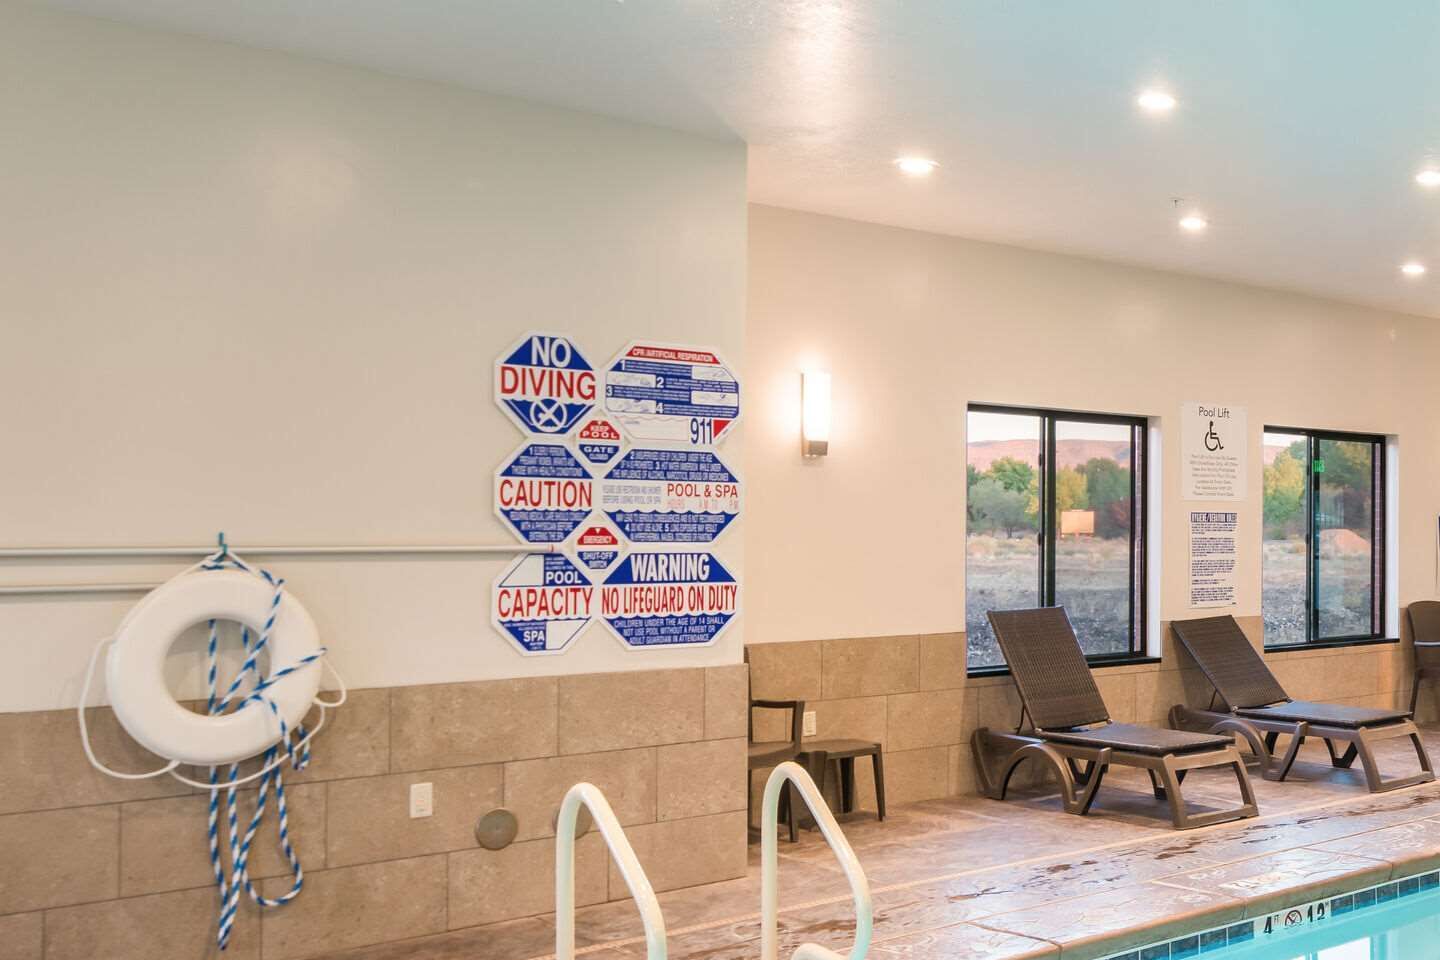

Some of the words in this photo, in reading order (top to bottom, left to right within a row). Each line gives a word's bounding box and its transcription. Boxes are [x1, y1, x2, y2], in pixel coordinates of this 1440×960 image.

[531, 336, 571, 368] NO
[500, 366, 596, 400] DIVING
[656, 377, 665, 389] 2
[606, 386, 613, 396] 3
[656, 403, 664, 414] 4
[1198, 406, 1216, 418] Pool
[1217, 408, 1230, 419] Lift
[582, 430, 617, 439] POOL
[690, 418, 713, 445] 911
[500, 479, 592, 507] CAUTION
[667, 483, 701, 497] POOL
[704, 485, 712, 497] &
[715, 485, 738, 498] SPA
[630, 553, 710, 582] WARNING
[545, 571, 582, 584] POOL
[498, 587, 593, 617] CAPACITY
[602, 586, 619, 614] NO
[623, 585, 684, 614] LIFEGUARD
[688, 584, 704, 612] ON
[708, 584, 737, 611] DUTY
[523, 630, 545, 642] SPA
